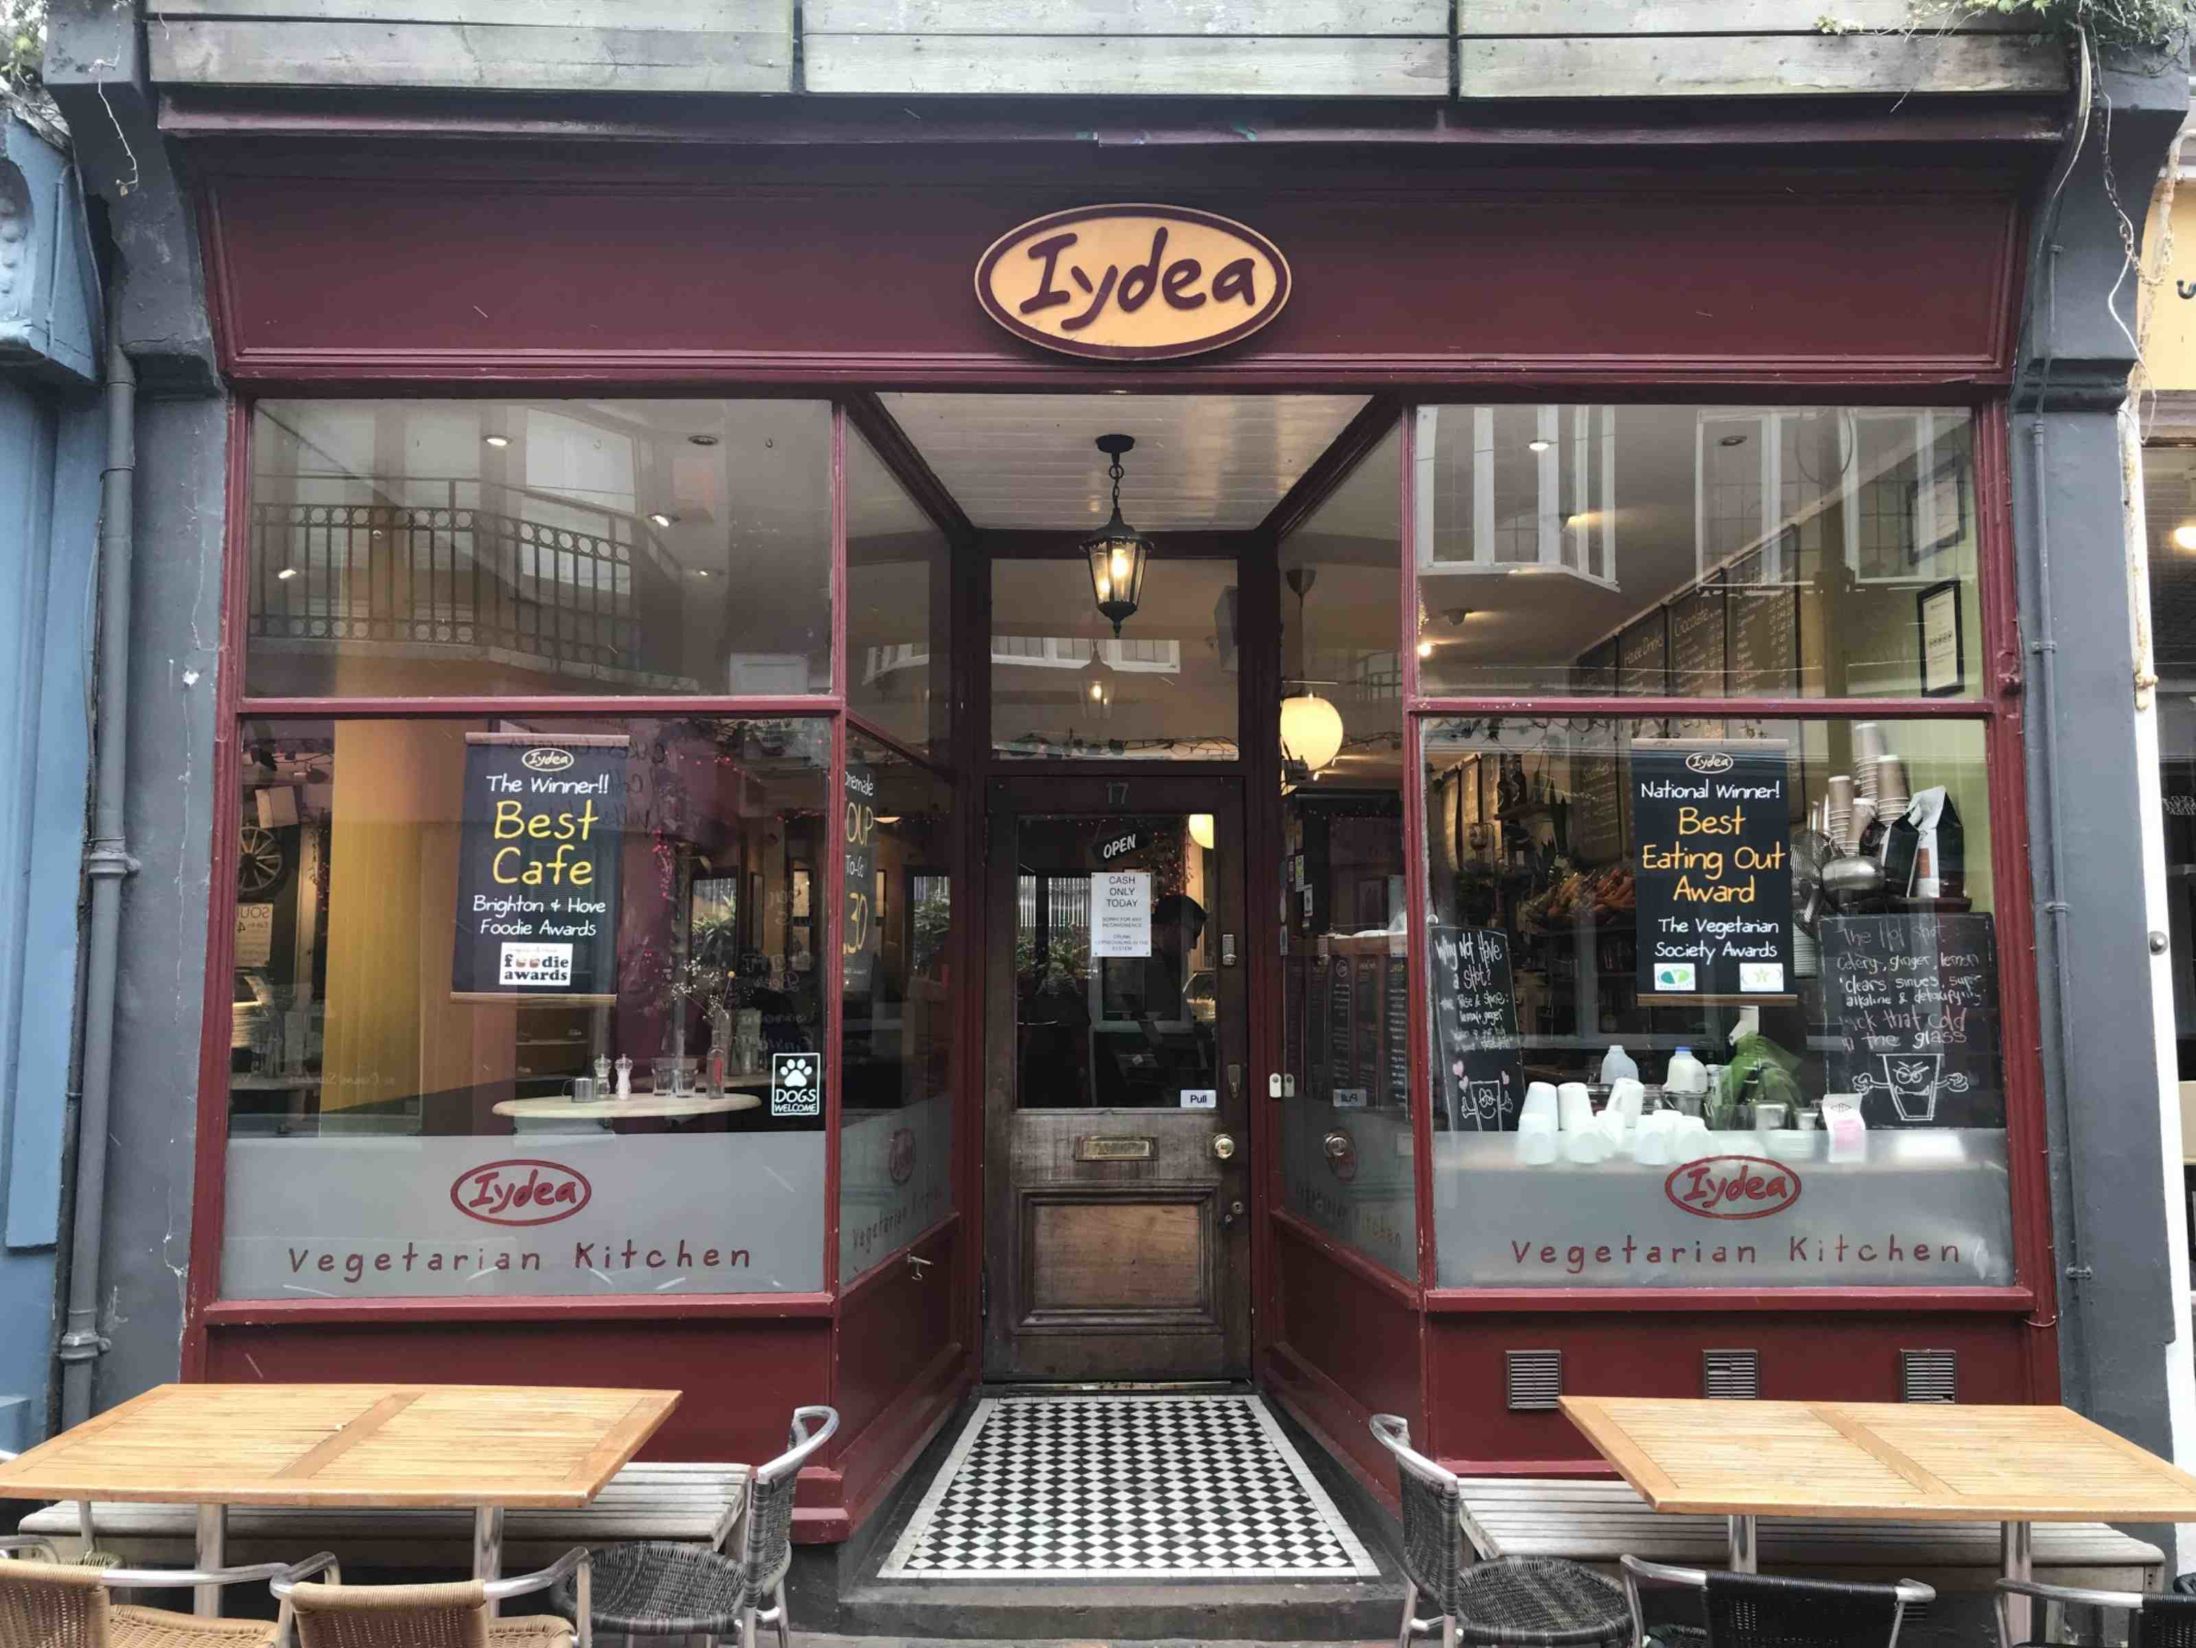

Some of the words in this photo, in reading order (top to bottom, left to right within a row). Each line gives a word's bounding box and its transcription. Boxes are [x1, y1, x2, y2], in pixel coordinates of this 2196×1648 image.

[1019, 226, 1256, 331] Iydea
[528, 752, 569, 766] Iydea
[1692, 755, 1729, 770] Iydea
[486, 773, 523, 794] The
[530, 774, 609, 795] Winner!!
[1105, 782, 1129, 804] 17
[1641, 779, 1709, 799] National
[1716, 781, 1780, 799] Winner!
[494, 799, 599, 841] Best
[1678, 805, 1746, 835] Best
[1103, 834, 1137, 860] OPEN
[492, 844, 593, 885] Cafe
[1642, 841, 1723, 880] Eating
[1734, 841, 1786, 870] Out
[1109, 875, 1136, 885] CASH
[1109, 887, 1136, 897] ONLY
[1673, 875, 1755, 903] Award
[473, 894, 544, 918] Brighton
[568, 898, 606, 913] Hove
[1106, 898, 1138, 908] TODAY
[480, 918, 532, 936] Foodie
[539, 920, 597, 936] Awards
[1658, 916, 1689, 933] The
[1695, 916, 1779, 940] Vegetarian
[1655, 940, 1716, 965] Society
[1722, 941, 1778, 958] Awards
[504, 969, 568, 981] awards
[1884, 1004, 1921, 1030] that
[1928, 1005, 1967, 1031] cold
[1913, 1030, 1967, 1049] glass
[774, 1088, 817, 1103] DOGS
[1190, 1094, 1207, 1104] Pull
[774, 1103, 817, 1113] WELCOME
[467, 1167, 578, 1214] Iydea
[1683, 1164, 1789, 1208] Iydea
[288, 1240, 541, 1283] Vegetarian
[575, 1239, 752, 1270] Kitchen
[1511, 1234, 1757, 1274] Vegetarian
[1789, 1234, 1961, 1264] Kitchen
